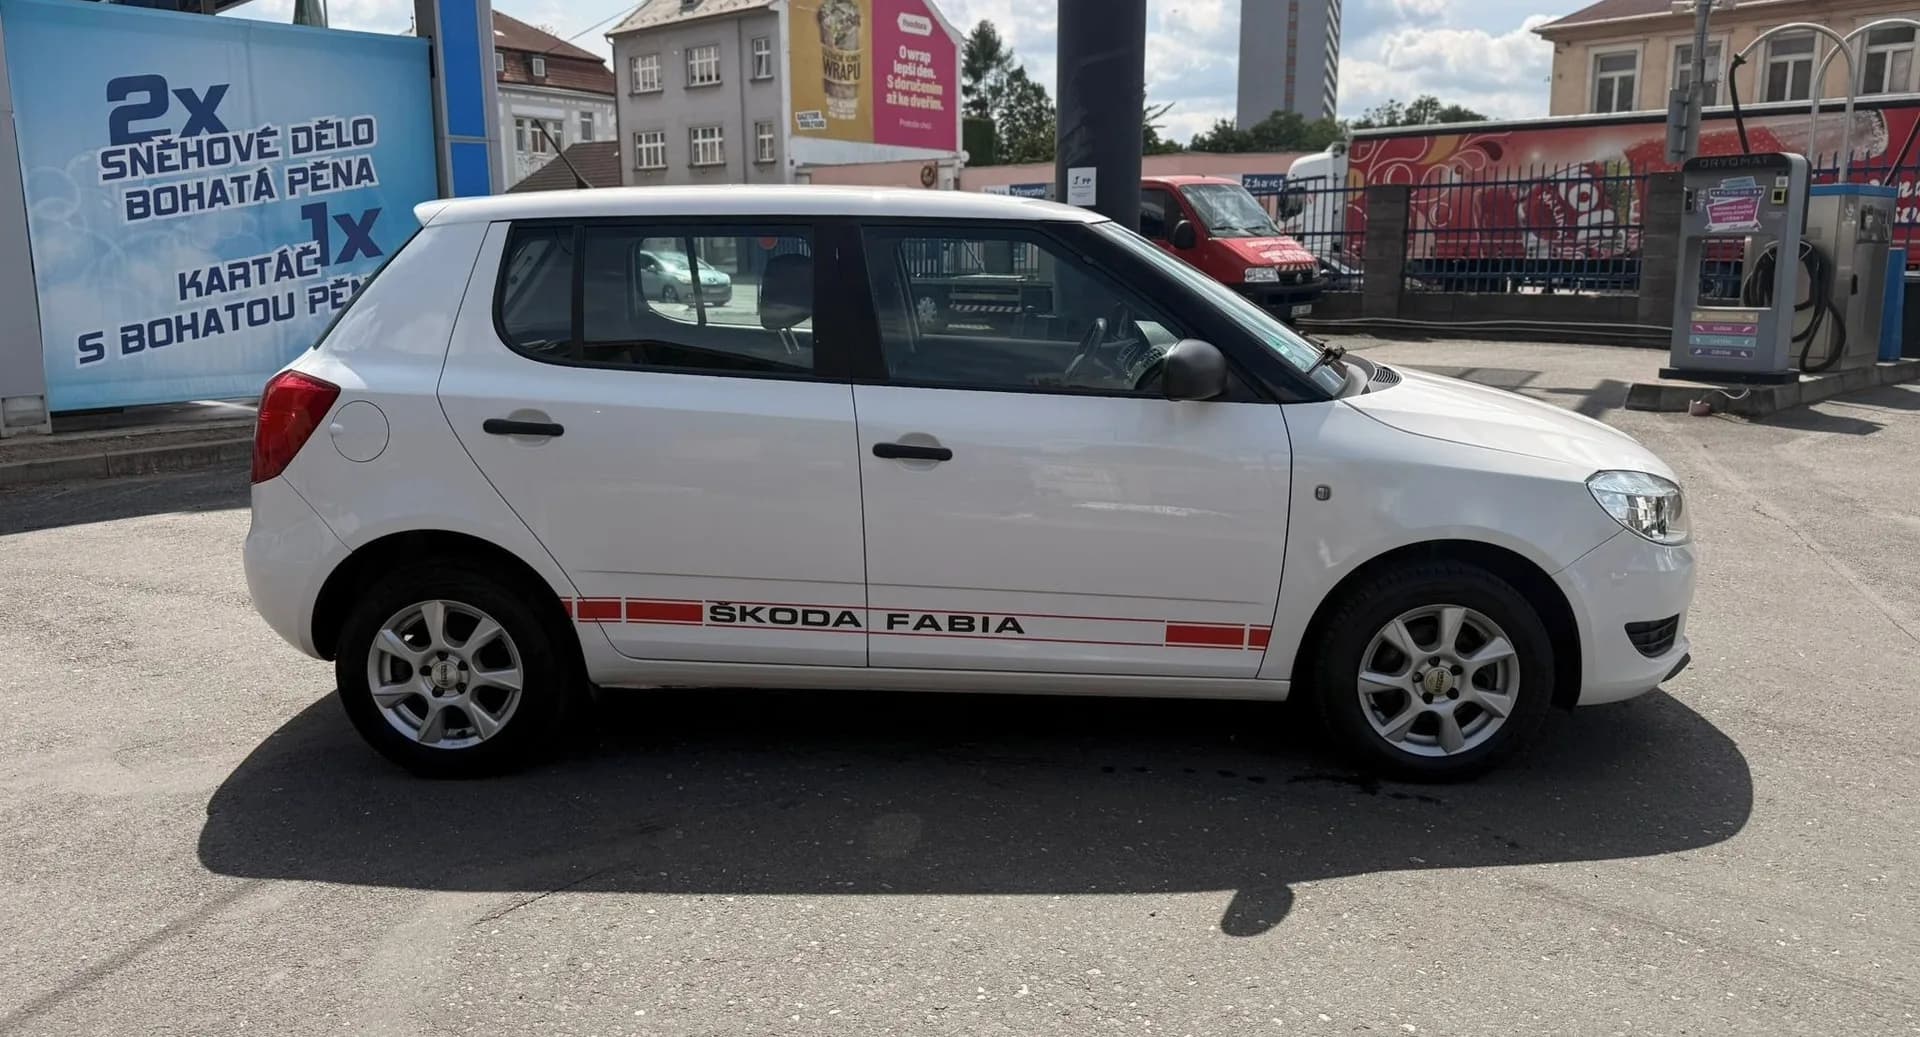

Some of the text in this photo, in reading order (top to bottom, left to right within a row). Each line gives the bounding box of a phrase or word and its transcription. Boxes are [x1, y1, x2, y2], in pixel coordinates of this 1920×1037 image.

[822, 55, 861, 81] WRAPU
[886, 74, 894, 89] S
[899, 45, 931, 66] O wrap
[106, 74, 230, 146] 2x
[101, 117, 375, 181] SNĚHOVÉ DĚLO
[125, 157, 376, 221] BOHATÁ PĚNA
[301, 201, 384, 267] 1x
[178, 245, 320, 301] KARTÁČ
[78, 330, 105, 365] S
[120, 292, 295, 356] BOHATOU
[709, 601, 1025, 634] ŠKODA FABIA
